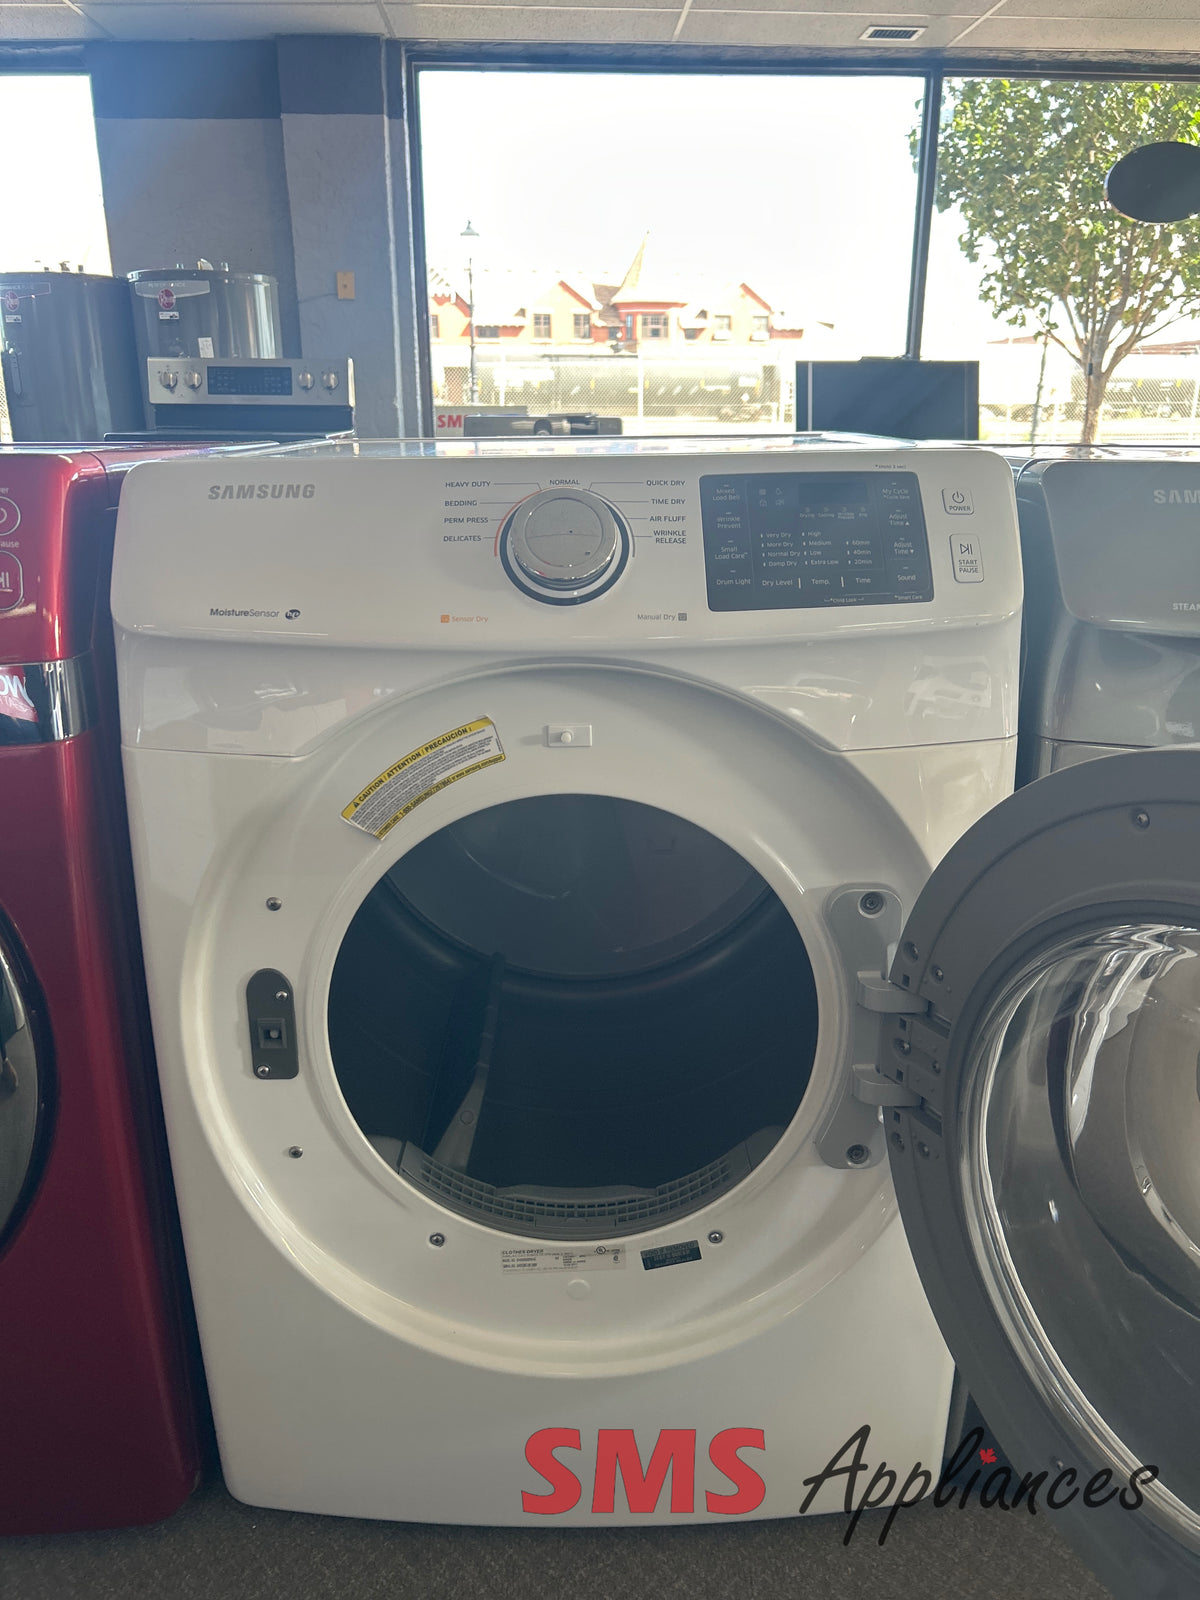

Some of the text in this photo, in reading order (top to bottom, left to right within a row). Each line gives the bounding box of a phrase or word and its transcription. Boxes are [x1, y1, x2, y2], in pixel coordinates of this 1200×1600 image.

[471, 480, 491, 488] DUTY
[207, 483, 316, 500] SAMSUNG
[466, 516, 489, 524] PRESS
[653, 529, 687, 537] WRINKLE
[780, 531, 792, 539] Dry
[768, 560, 798, 569] Damp Dry
[734, 578, 751, 586] Light
[762, 579, 774, 587] Dry
[451, 615, 489, 624] Sensor Dry
[637, 613, 676, 622] Manual Dry
[358, 777, 384, 802] CAUTION
[387, 751, 422, 778] ATTENTION
[424, 726, 468, 753] PRECAUCIÓN
